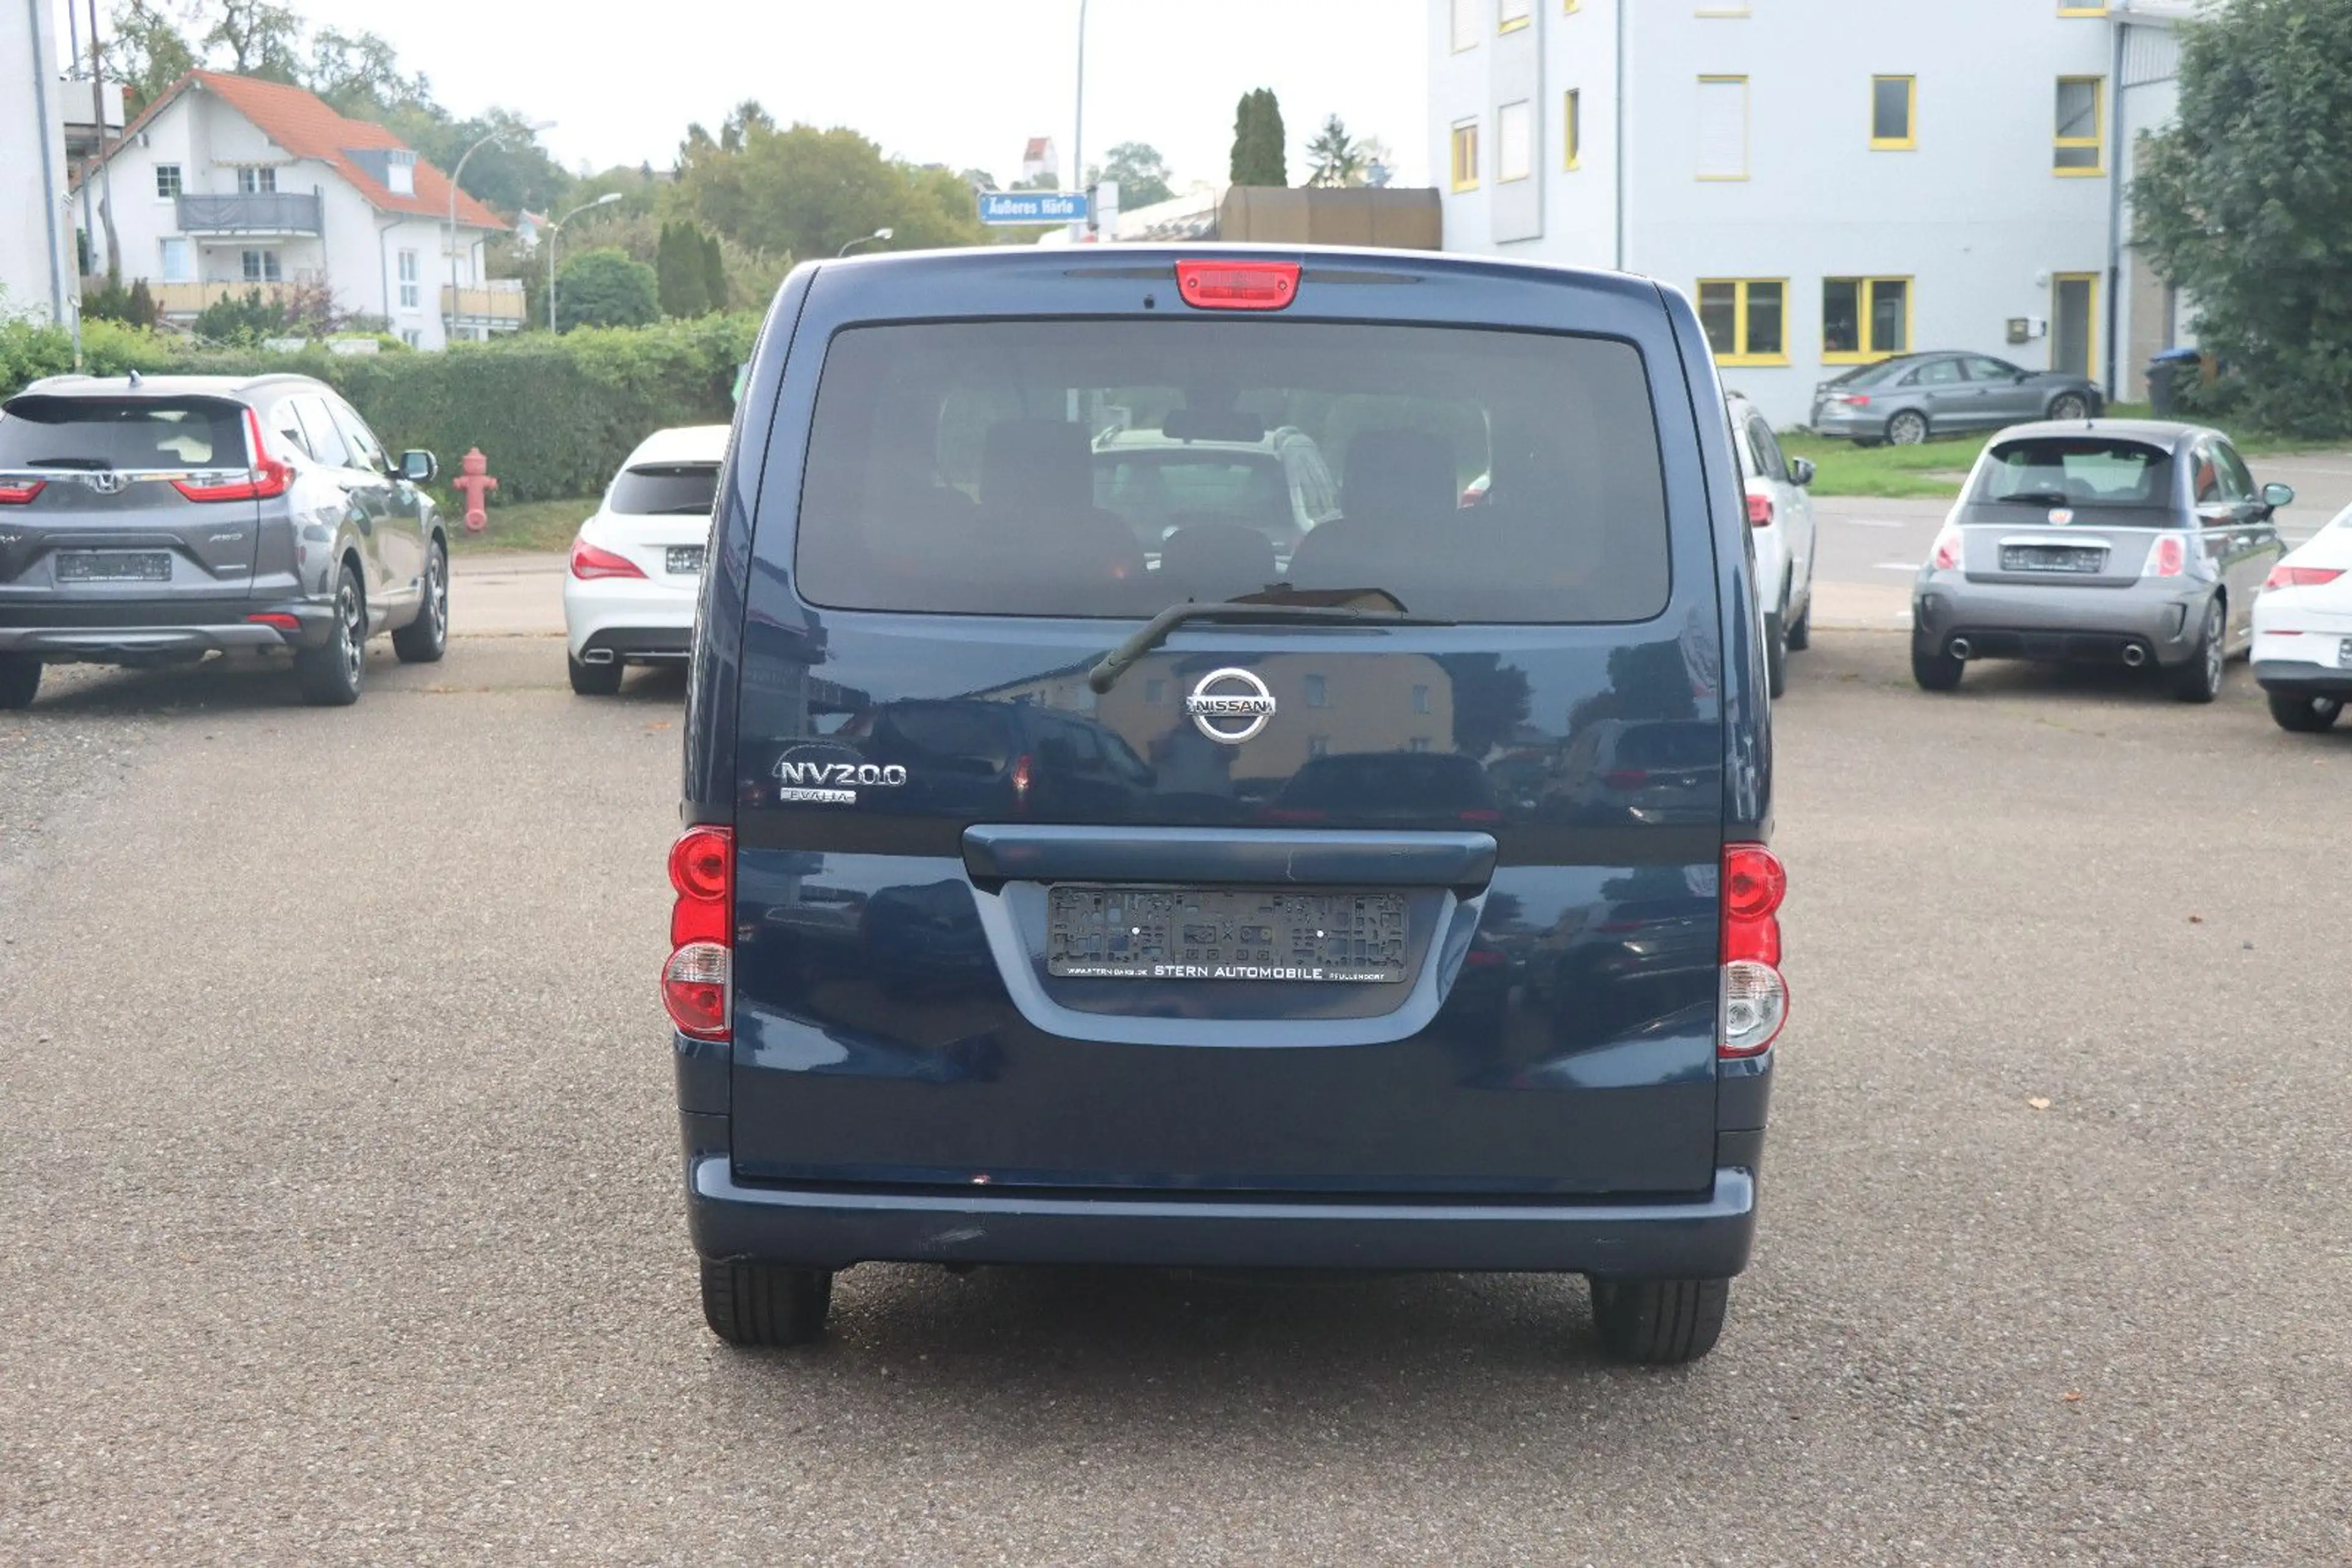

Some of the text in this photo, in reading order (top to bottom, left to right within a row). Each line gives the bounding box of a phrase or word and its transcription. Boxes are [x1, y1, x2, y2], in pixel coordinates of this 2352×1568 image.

[989, 197, 1036, 214] Äußeres
[1196, 701, 1266, 712] NISSAN
[781, 762, 907, 786] NV200
[1154, 965, 1208, 977] STERN
[1214, 967, 1323, 979] AUTOMOBILE
